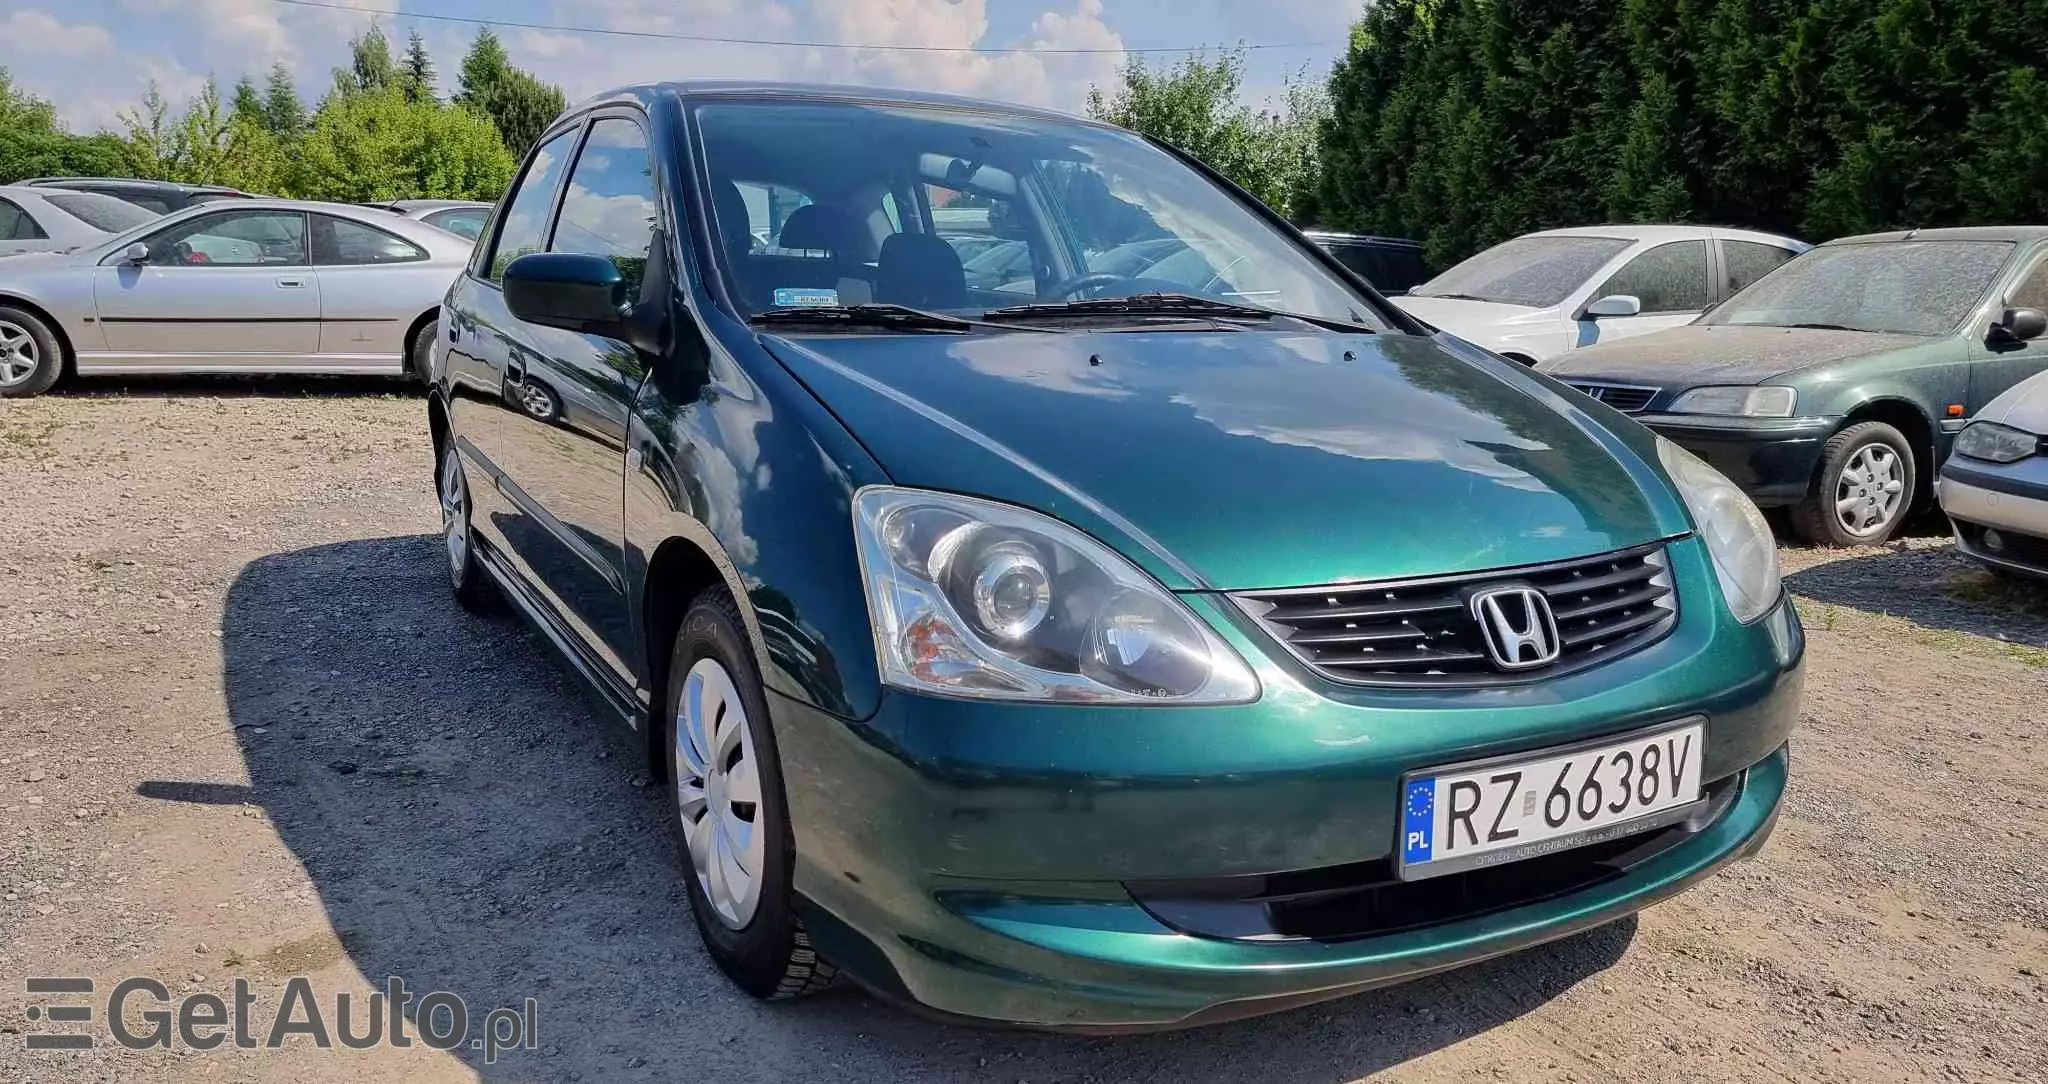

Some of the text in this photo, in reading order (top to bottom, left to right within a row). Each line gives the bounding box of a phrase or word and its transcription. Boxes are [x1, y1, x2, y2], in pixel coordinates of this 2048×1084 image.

[1446, 734, 1692, 850] RZ 6638V
[1408, 831, 1429, 851] PL
